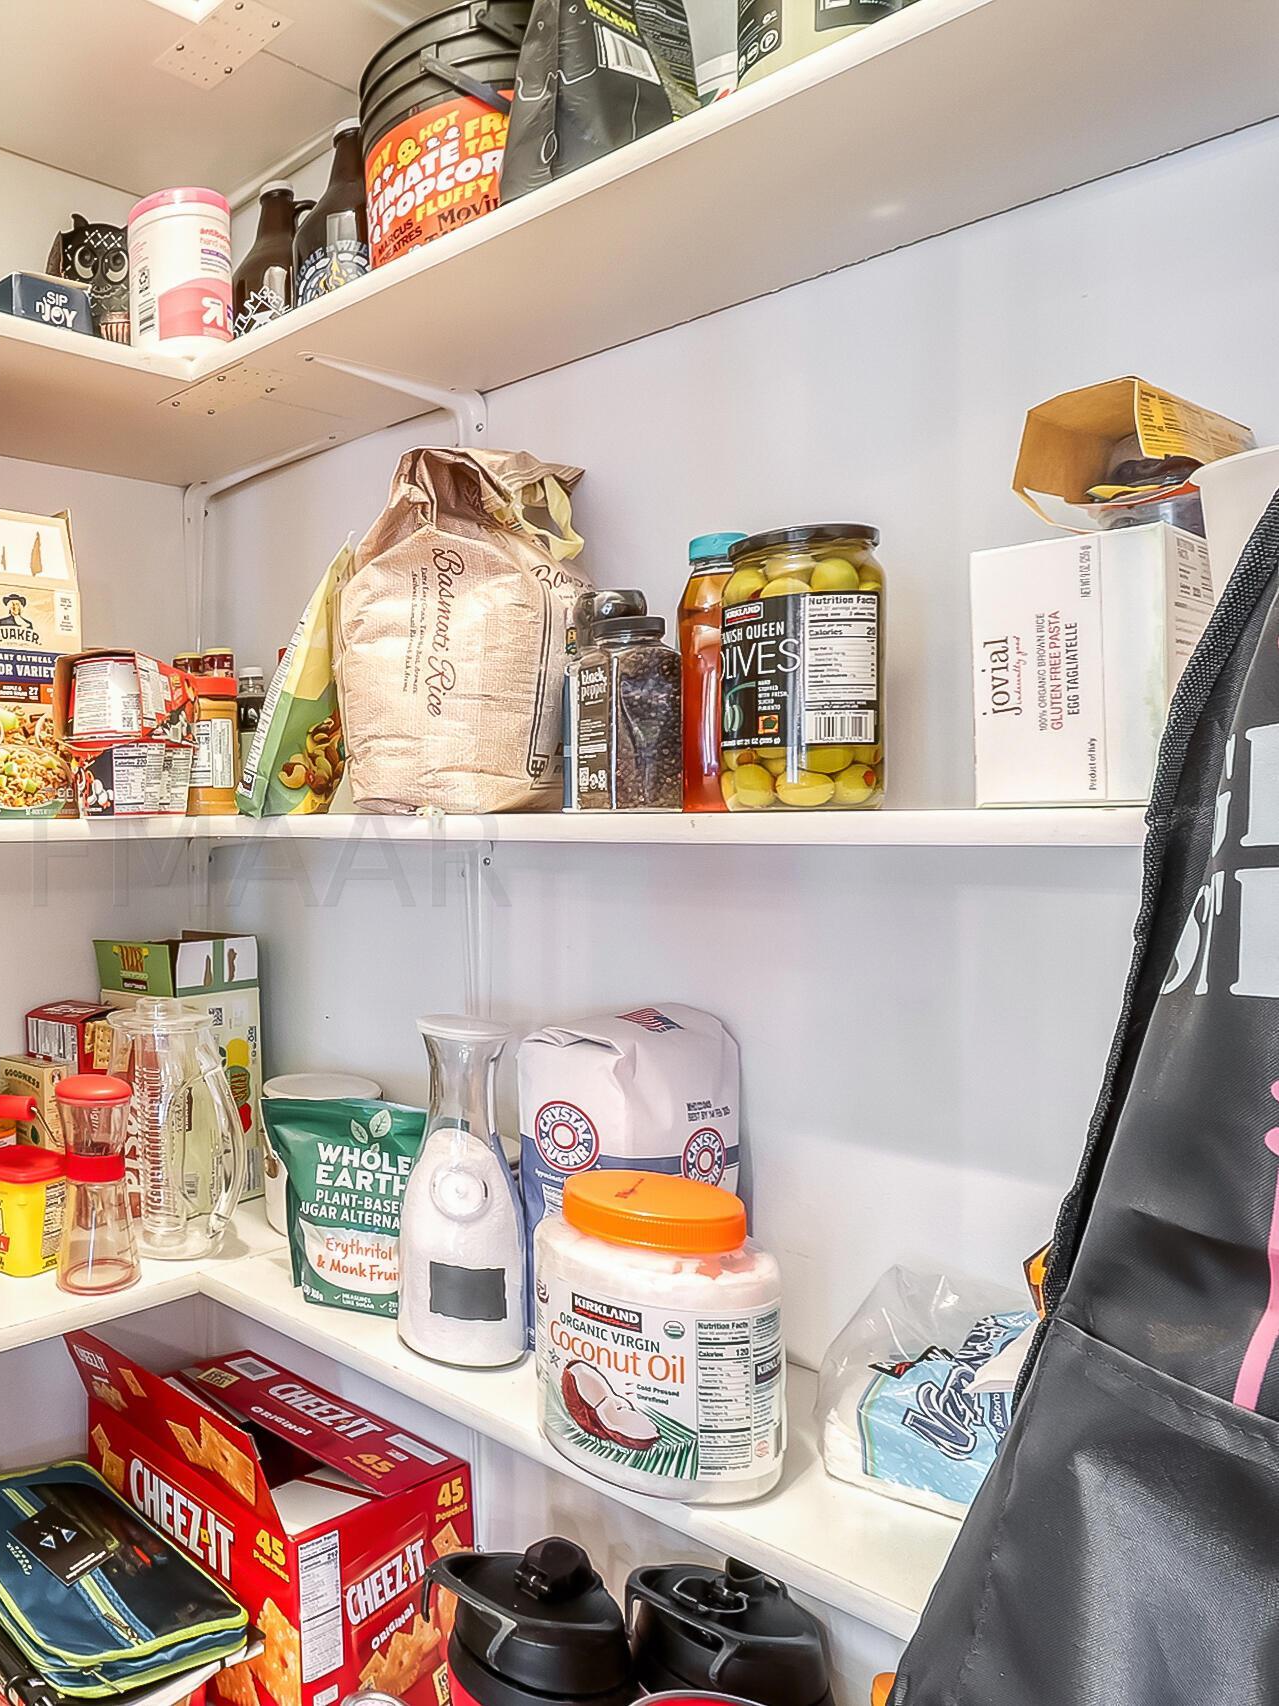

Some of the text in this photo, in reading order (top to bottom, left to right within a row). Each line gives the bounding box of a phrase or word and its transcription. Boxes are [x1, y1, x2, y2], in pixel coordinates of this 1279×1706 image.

[419, 110, 460, 143] HOT
[381, 149, 504, 234] POPCOR
[415, 175, 495, 222] FLUFFY
[378, 218, 414, 256] MARCUS
[46, 290, 68, 306] SIP
[726, 604, 761, 619] KIRKLAND
[808, 594, 876, 605] Nutrition Facts
[424, 548, 465, 718] Basmati Rice
[746, 621, 785, 639] QUEEN
[808, 628, 843, 637] Calories
[1035, 613, 1046, 633] RICE
[16, 654, 52, 664] OATMEAL
[16, 664, 56, 678] VARIET
[1047, 610, 1064, 731] GLUTEN FREE PASTA
[1064, 622, 1080, 715] EGG TAGLIATELLE
[580, 668, 606, 686] black
[981, 635, 1023, 716] jovial
[28, 686, 39, 696] 27
[580, 681, 608, 702] pepper
[4, 1068, 41, 1089] GOODNESS
[539, 1106, 592, 1143] CRYSTAL
[316, 1142, 413, 1175] WHOLE
[540, 1137, 591, 1166] SUGAR
[686, 1134, 722, 1163] CRYSTAL
[315, 1165, 407, 1196] EARTH
[315, 1189, 403, 1214] PLANT-BASE
[340, 1206, 400, 1229] ALTERNA
[324, 1237, 393, 1261] Erythritol
[316, 1254, 400, 1282] & Monk Frui
[573, 1295, 641, 1324] KIRKLAND
[559, 1312, 608, 1341] ORGANIC
[610, 1333, 661, 1354] VIRGIN
[697, 1321, 749, 1330] Nutrition Facts
[549, 1320, 686, 1385] Coconut Oil
[698, 1347, 749, 1358] Calories 120
[636, 1383, 680, 1398] Cold Pressed
[636, 1393, 670, 1406] Unrefined
[250, 1405, 313, 1438] ORIGINAL
[344, 1454, 383, 1481] Pouches
[356, 1452, 396, 1475] 45
[436, 1475, 465, 1508] 45
[435, 1501, 469, 1524] Pouches
[254, 1528, 287, 1563] 45
[252, 1548, 290, 1584] Pouches
[370, 1602, 415, 1651] ORIGINAL
